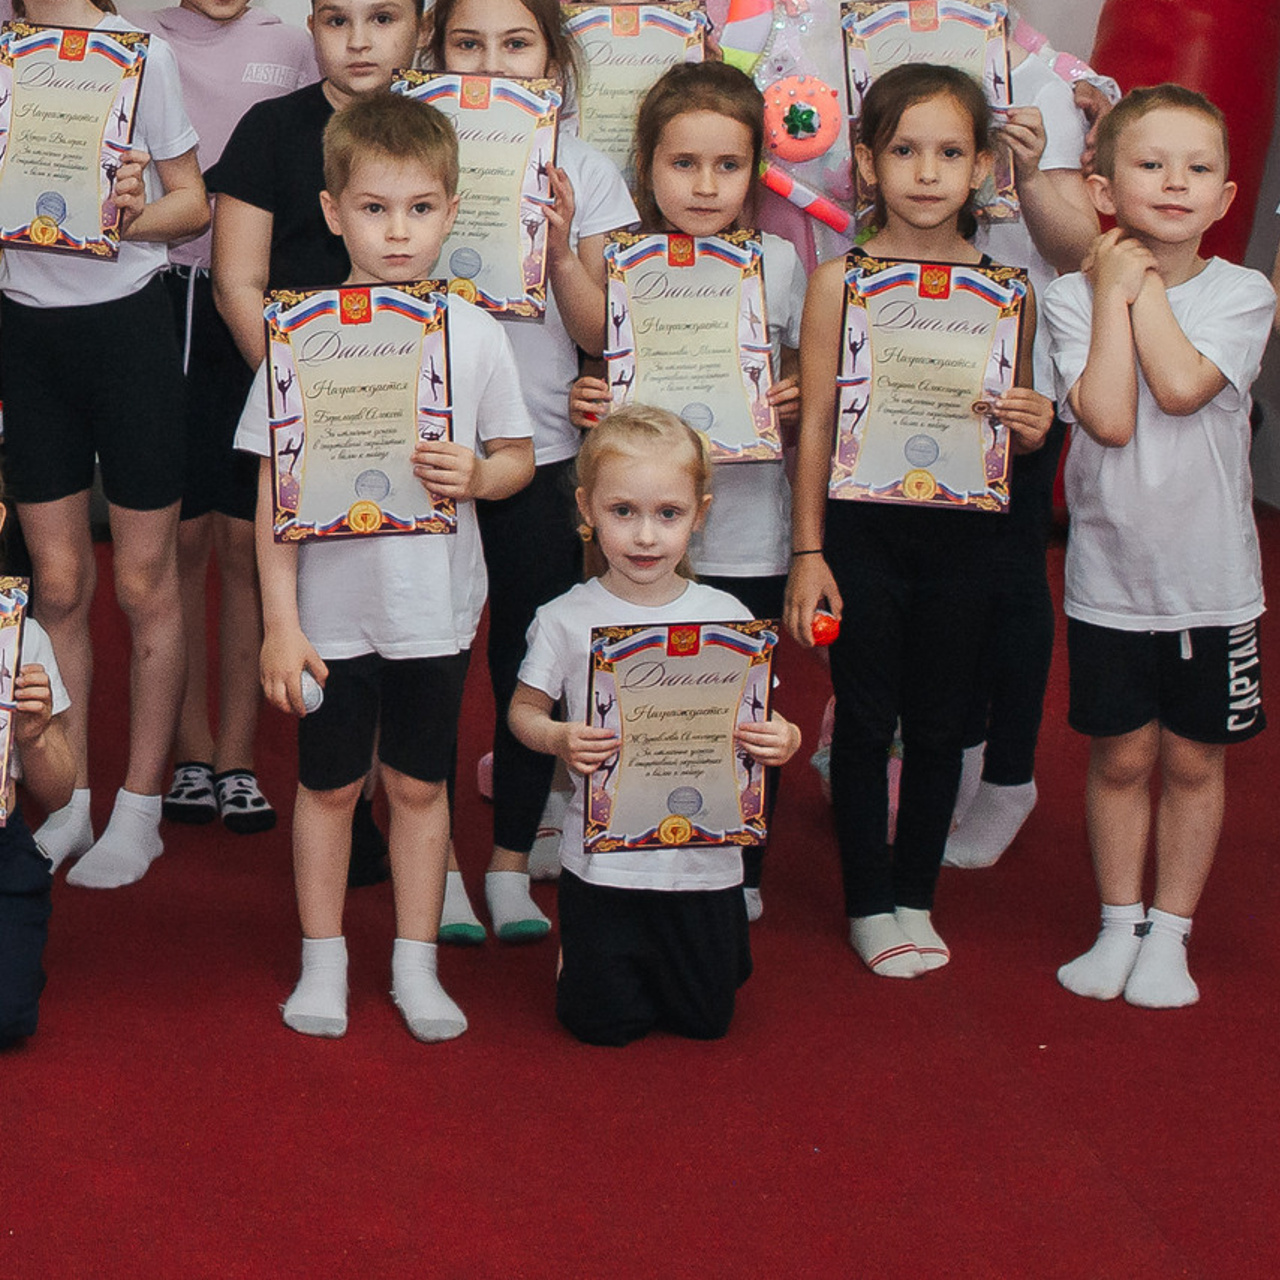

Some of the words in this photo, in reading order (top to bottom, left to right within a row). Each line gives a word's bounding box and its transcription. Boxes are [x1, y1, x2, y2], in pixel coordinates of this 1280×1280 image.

[582, 40, 679, 66] Диплом
[16, 61, 115, 92] Диплом
[631, 271, 737, 305] Диплом
[872, 300, 990, 335] Диплом
[298, 330, 417, 367] Диплом
[305, 379, 408, 399] Награждается
[621, 661, 742, 693] Диплом
